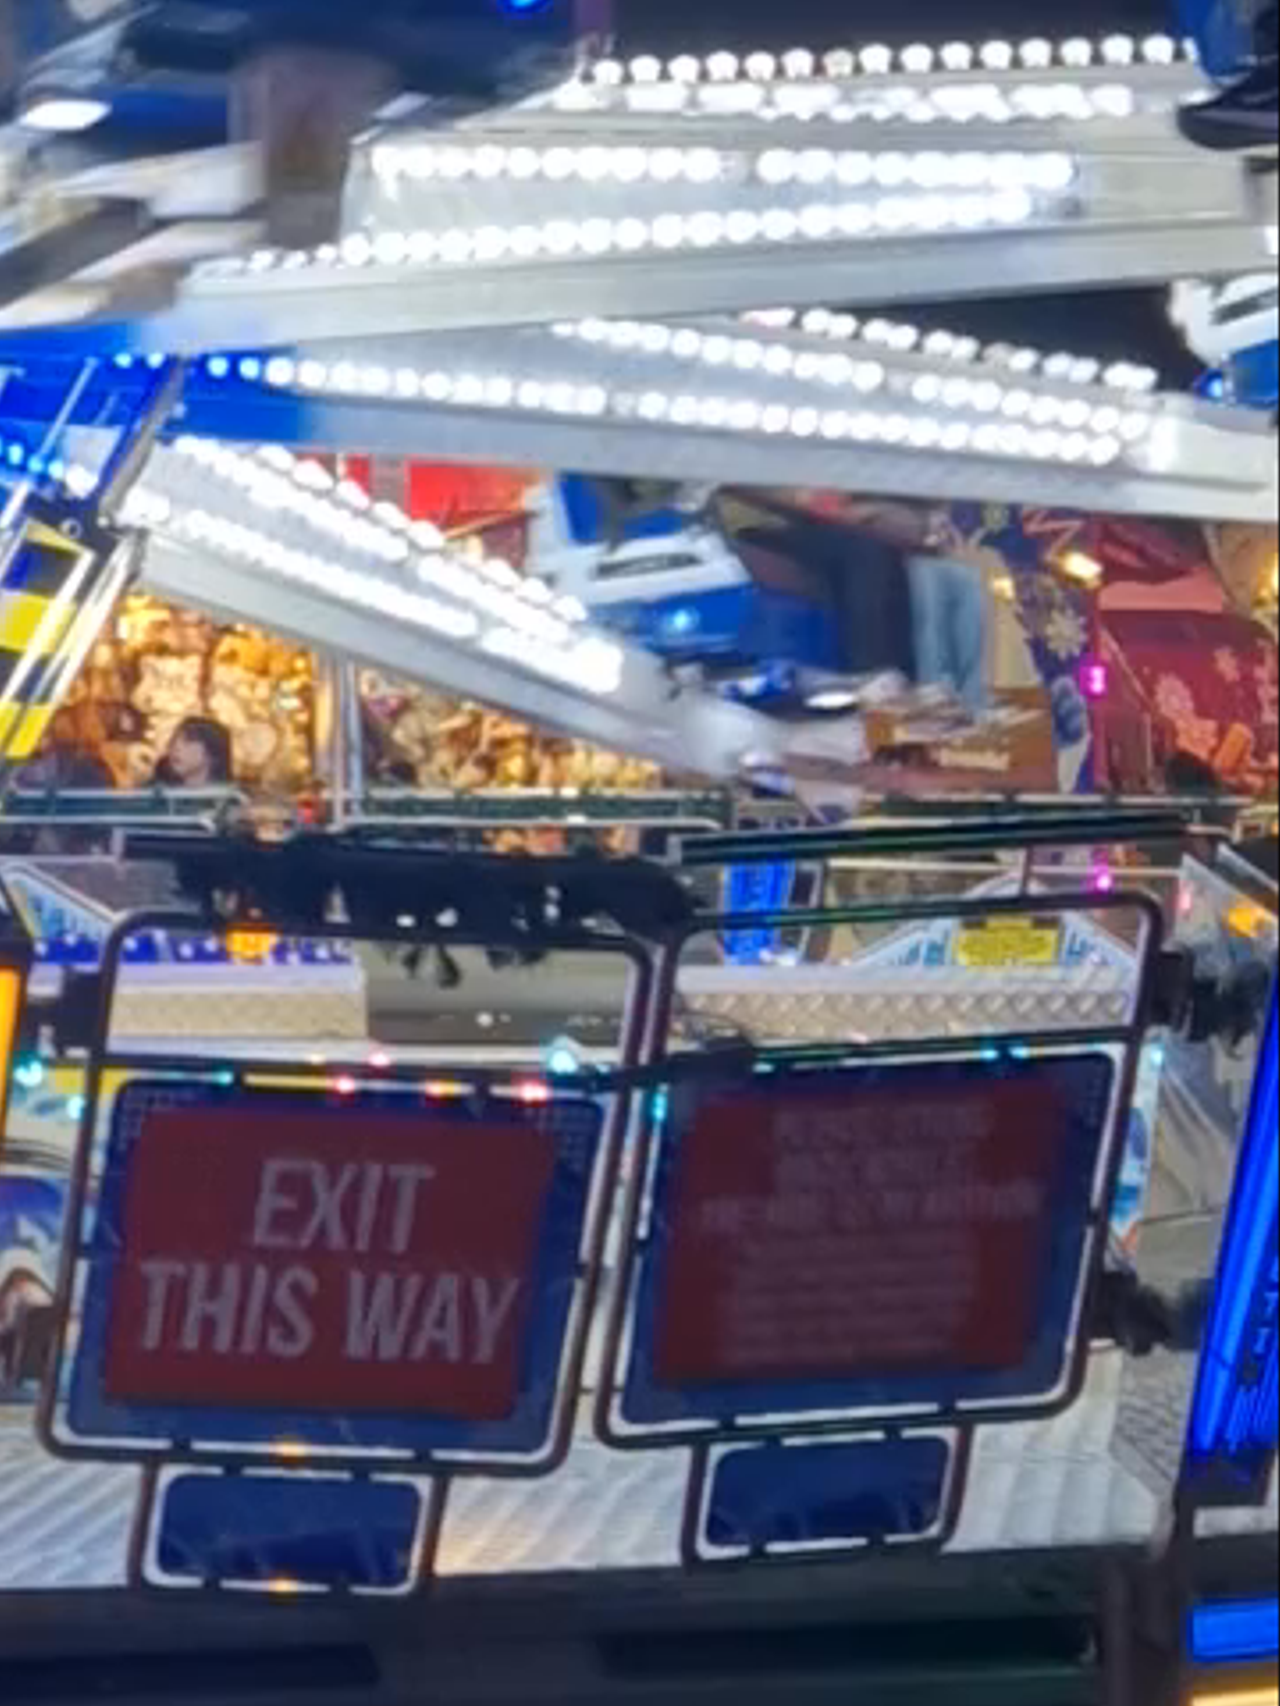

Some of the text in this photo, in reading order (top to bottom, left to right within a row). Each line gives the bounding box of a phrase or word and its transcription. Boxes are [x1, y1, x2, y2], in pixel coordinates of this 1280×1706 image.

[252, 1158, 436, 1254] EXIT
[139, 1260, 520, 1365] THIS WAY
